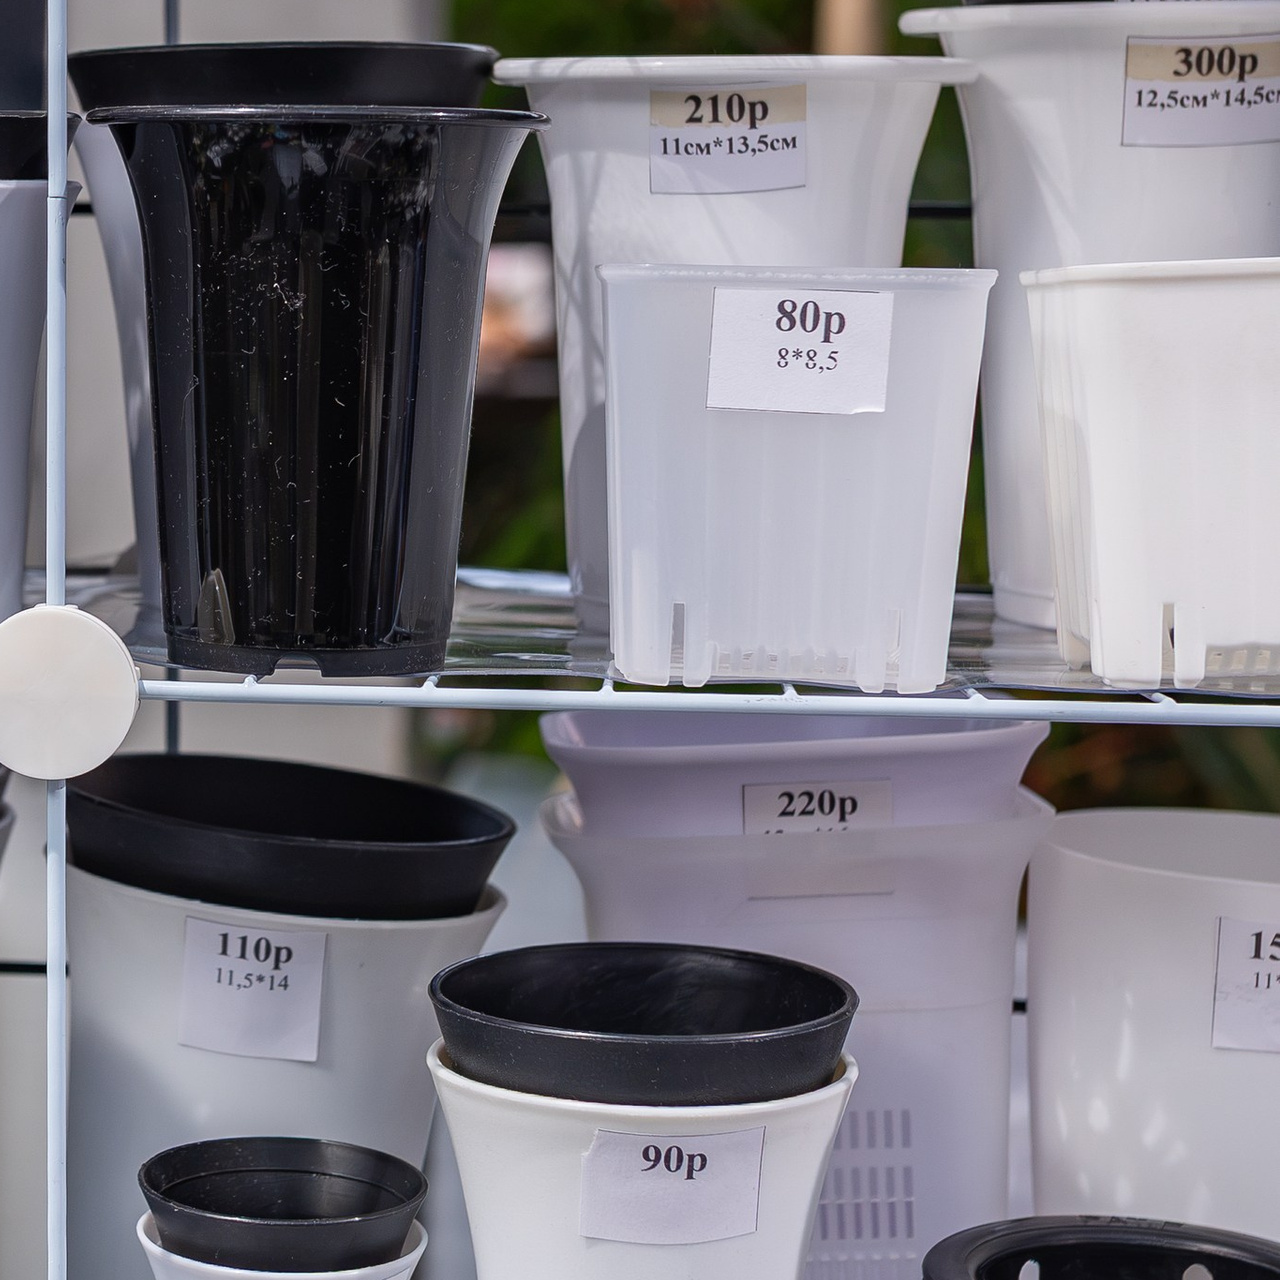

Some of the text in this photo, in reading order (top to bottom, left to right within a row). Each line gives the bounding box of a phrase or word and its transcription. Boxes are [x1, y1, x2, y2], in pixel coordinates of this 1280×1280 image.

[1173, 47, 1259, 82] 300р
[683, 95, 769, 129] 210р
[774, 298, 847, 344] 80р
[777, 789, 858, 823] 220р
[215, 932, 293, 970] 110р
[1250, 931, 1280, 961] 15
[1253, 970, 1280, 990] 11
[640, 1144, 708, 1181] 90р
